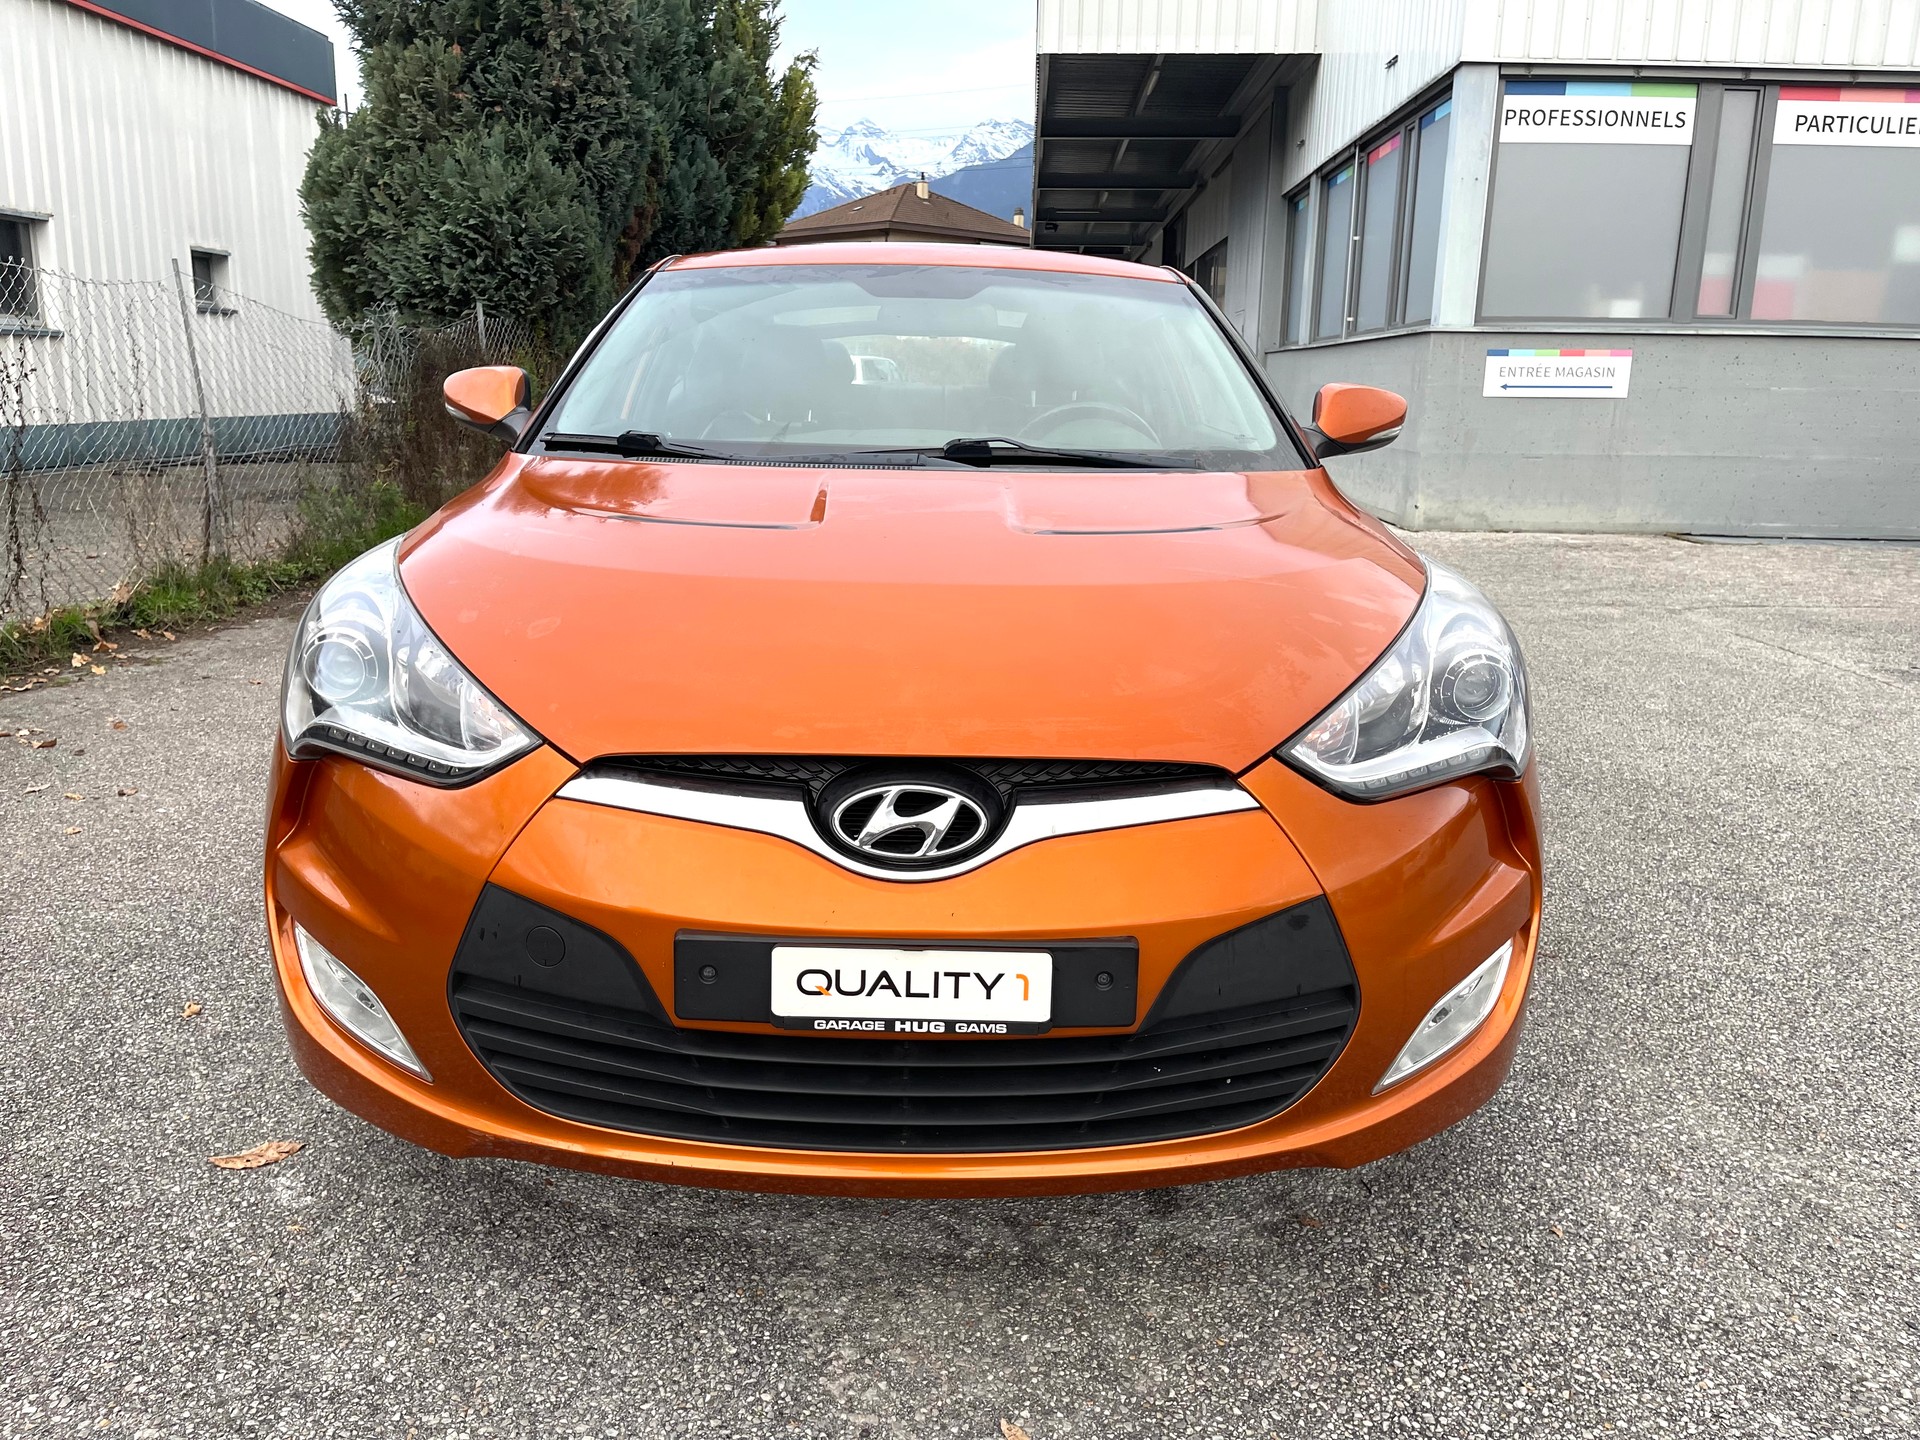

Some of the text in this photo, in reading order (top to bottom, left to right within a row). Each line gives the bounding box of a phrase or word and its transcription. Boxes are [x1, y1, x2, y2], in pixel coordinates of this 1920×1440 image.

[1504, 109, 1687, 128] PROFESSIONNELS
[1794, 114, 1920, 135] PARTICULIE
[1499, 363, 1616, 378] ENTRÉE MAGASIN
[813, 1019, 1007, 1034] GARAGE HUG GAMS
